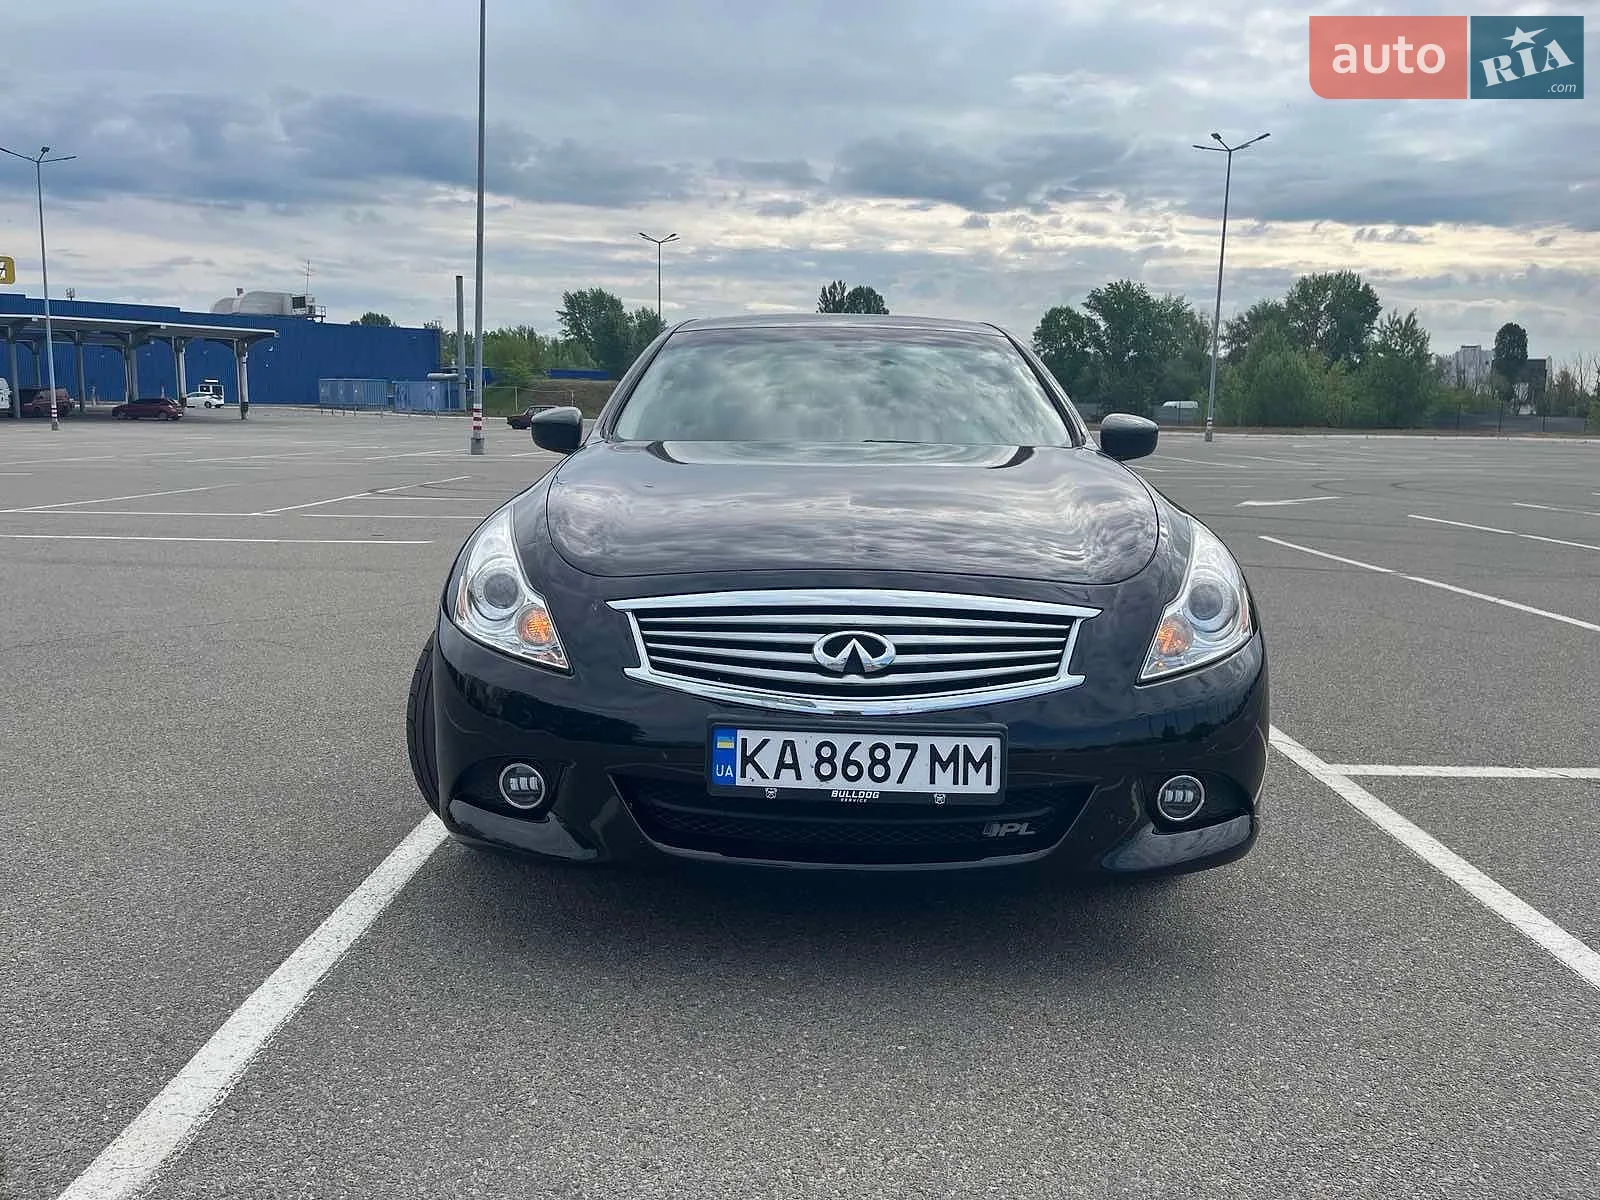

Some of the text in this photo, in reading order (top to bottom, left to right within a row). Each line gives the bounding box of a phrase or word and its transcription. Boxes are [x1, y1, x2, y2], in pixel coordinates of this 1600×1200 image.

[739, 737, 993, 786] KA 8687 MM
[715, 763, 734, 778] UA
[831, 790, 880, 799] BULLDOG
